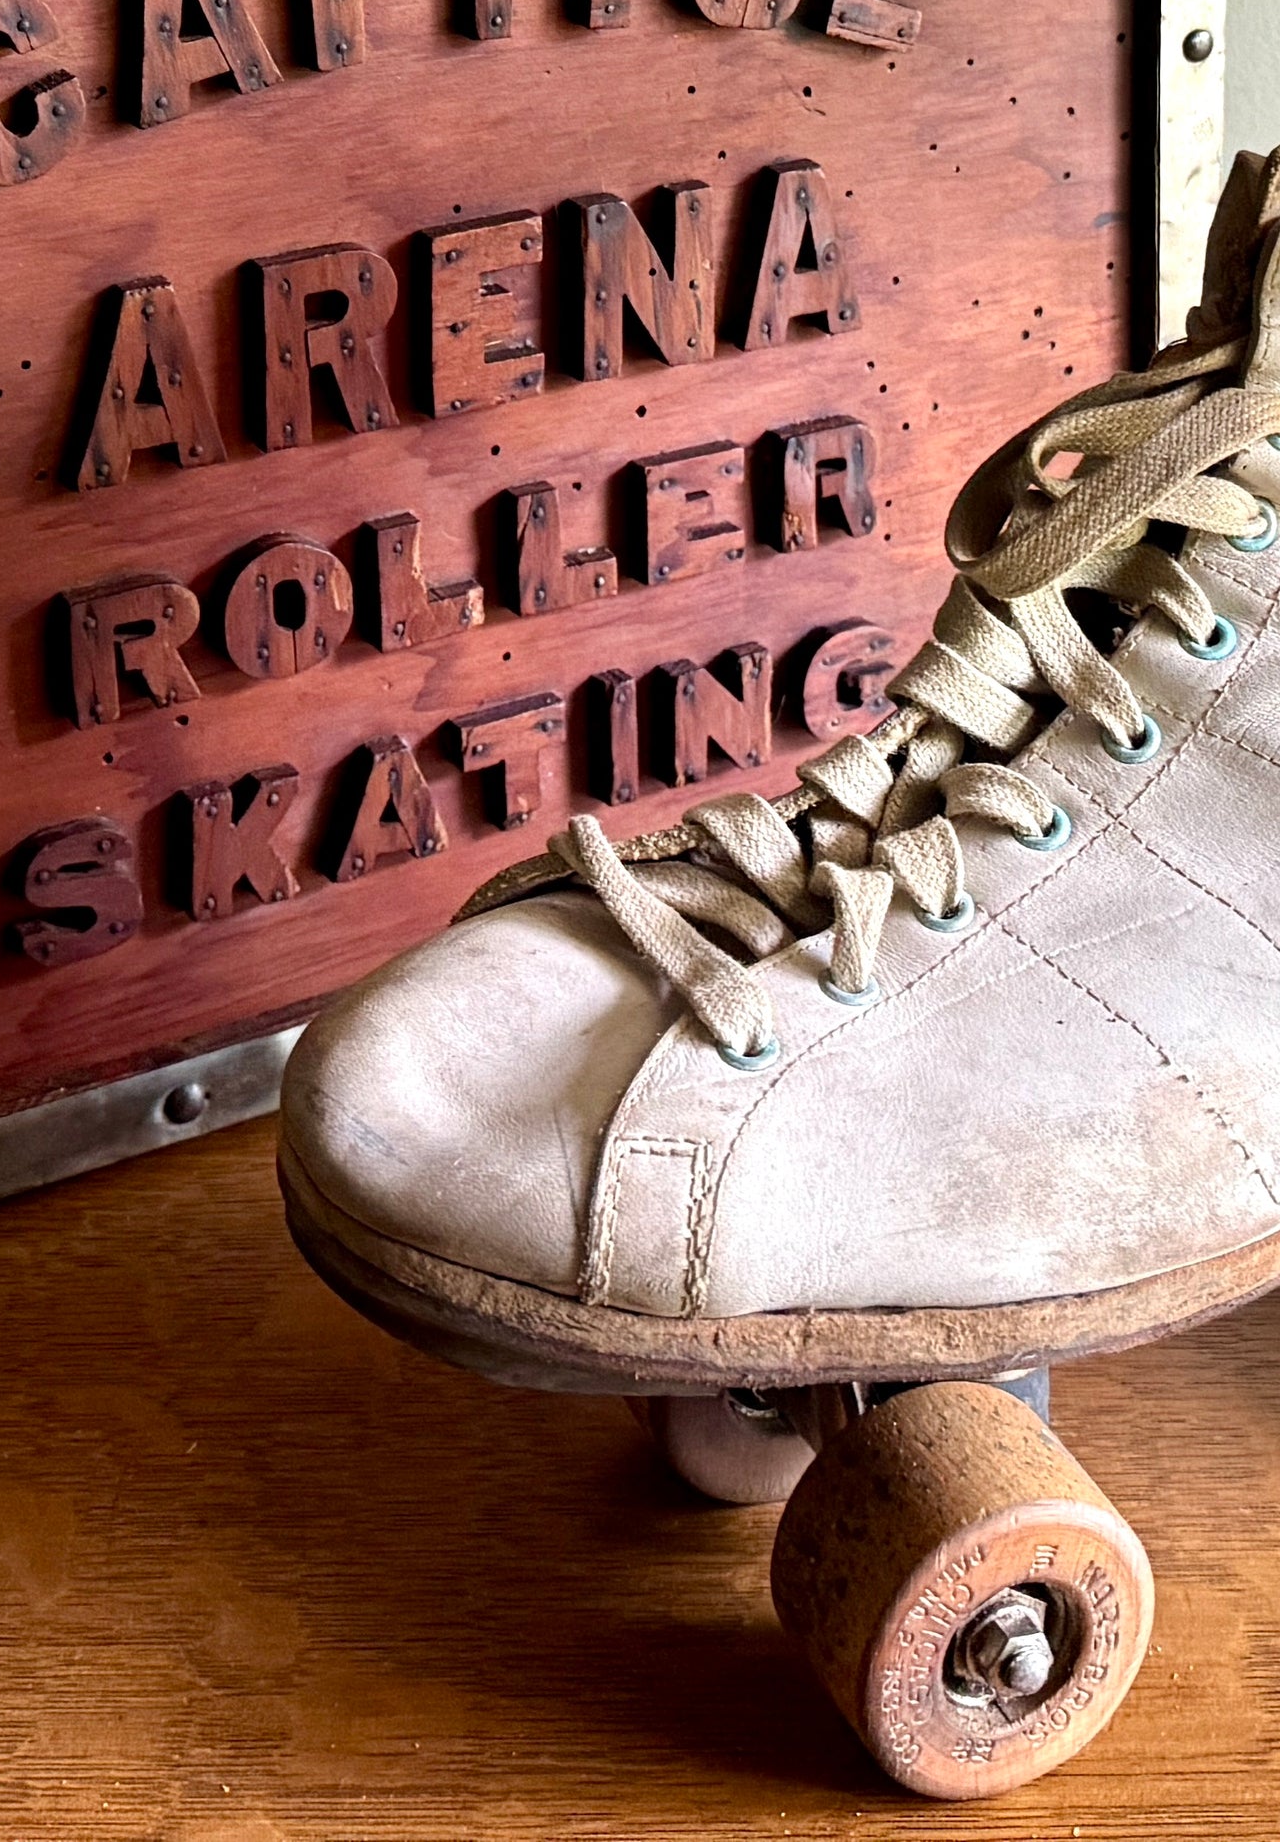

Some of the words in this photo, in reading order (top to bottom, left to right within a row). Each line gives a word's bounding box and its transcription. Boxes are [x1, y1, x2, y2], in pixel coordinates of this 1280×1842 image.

[60, 158, 863, 493] ARENA
[57, 414, 878, 730] ROLLER
[10, 616, 899, 960] SKATING
